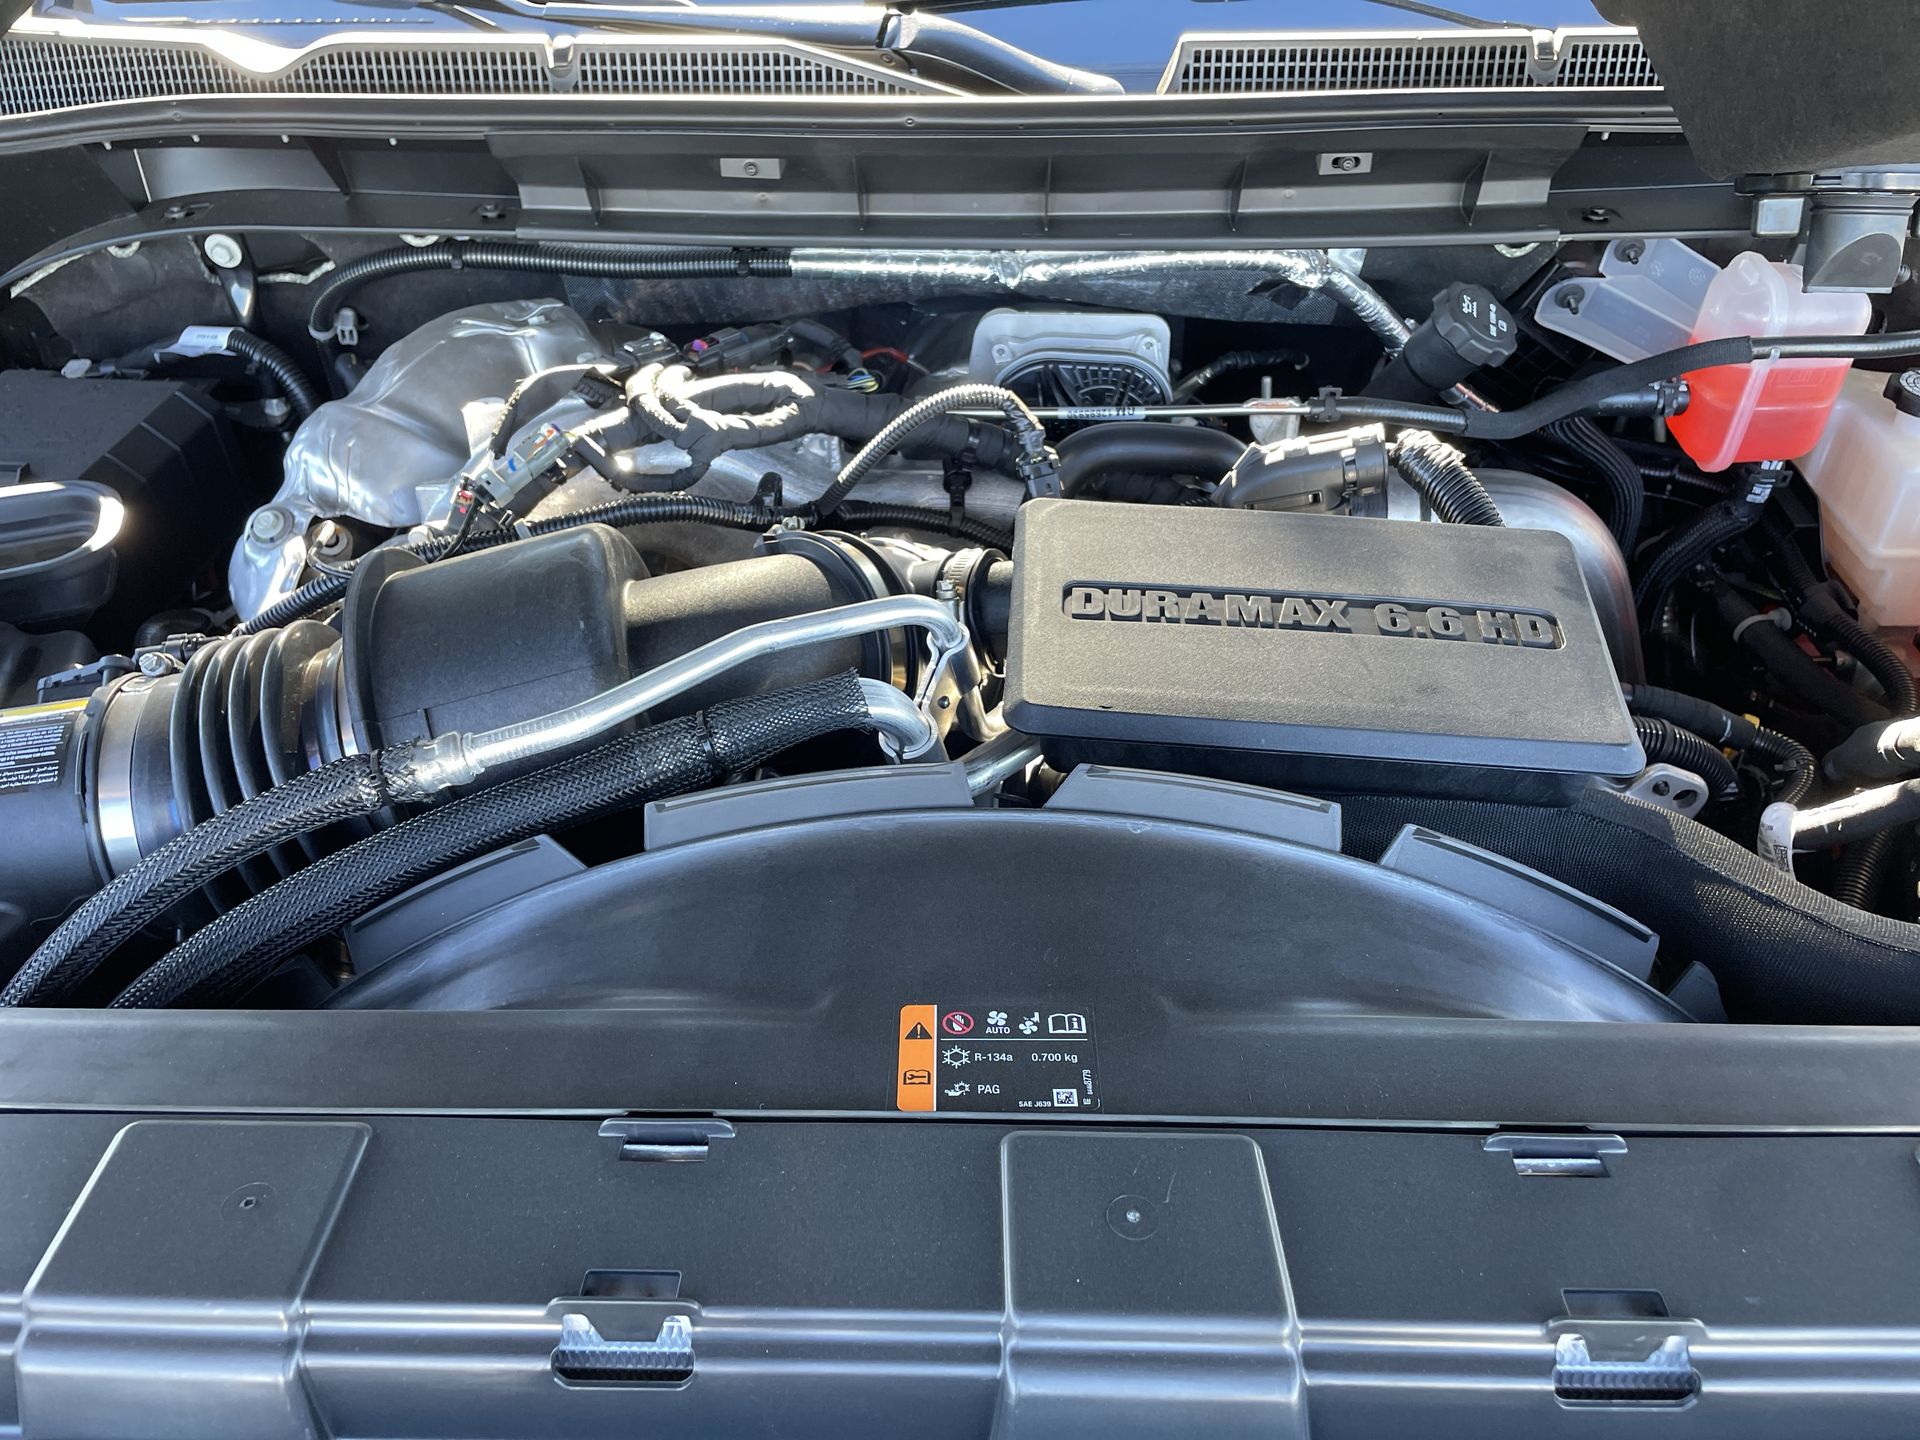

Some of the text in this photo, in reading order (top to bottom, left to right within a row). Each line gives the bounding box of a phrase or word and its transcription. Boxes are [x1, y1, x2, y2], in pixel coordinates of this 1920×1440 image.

[1071, 587, 1555, 644] DURAMAX 6.6 HD
[985, 1026, 1011, 1034] AUTO
[974, 1052, 1078, 1063] R-134a 0.700 kg
[977, 1084, 1001, 1094] PAG
[1018, 1100, 1052, 1108] SAE J639
